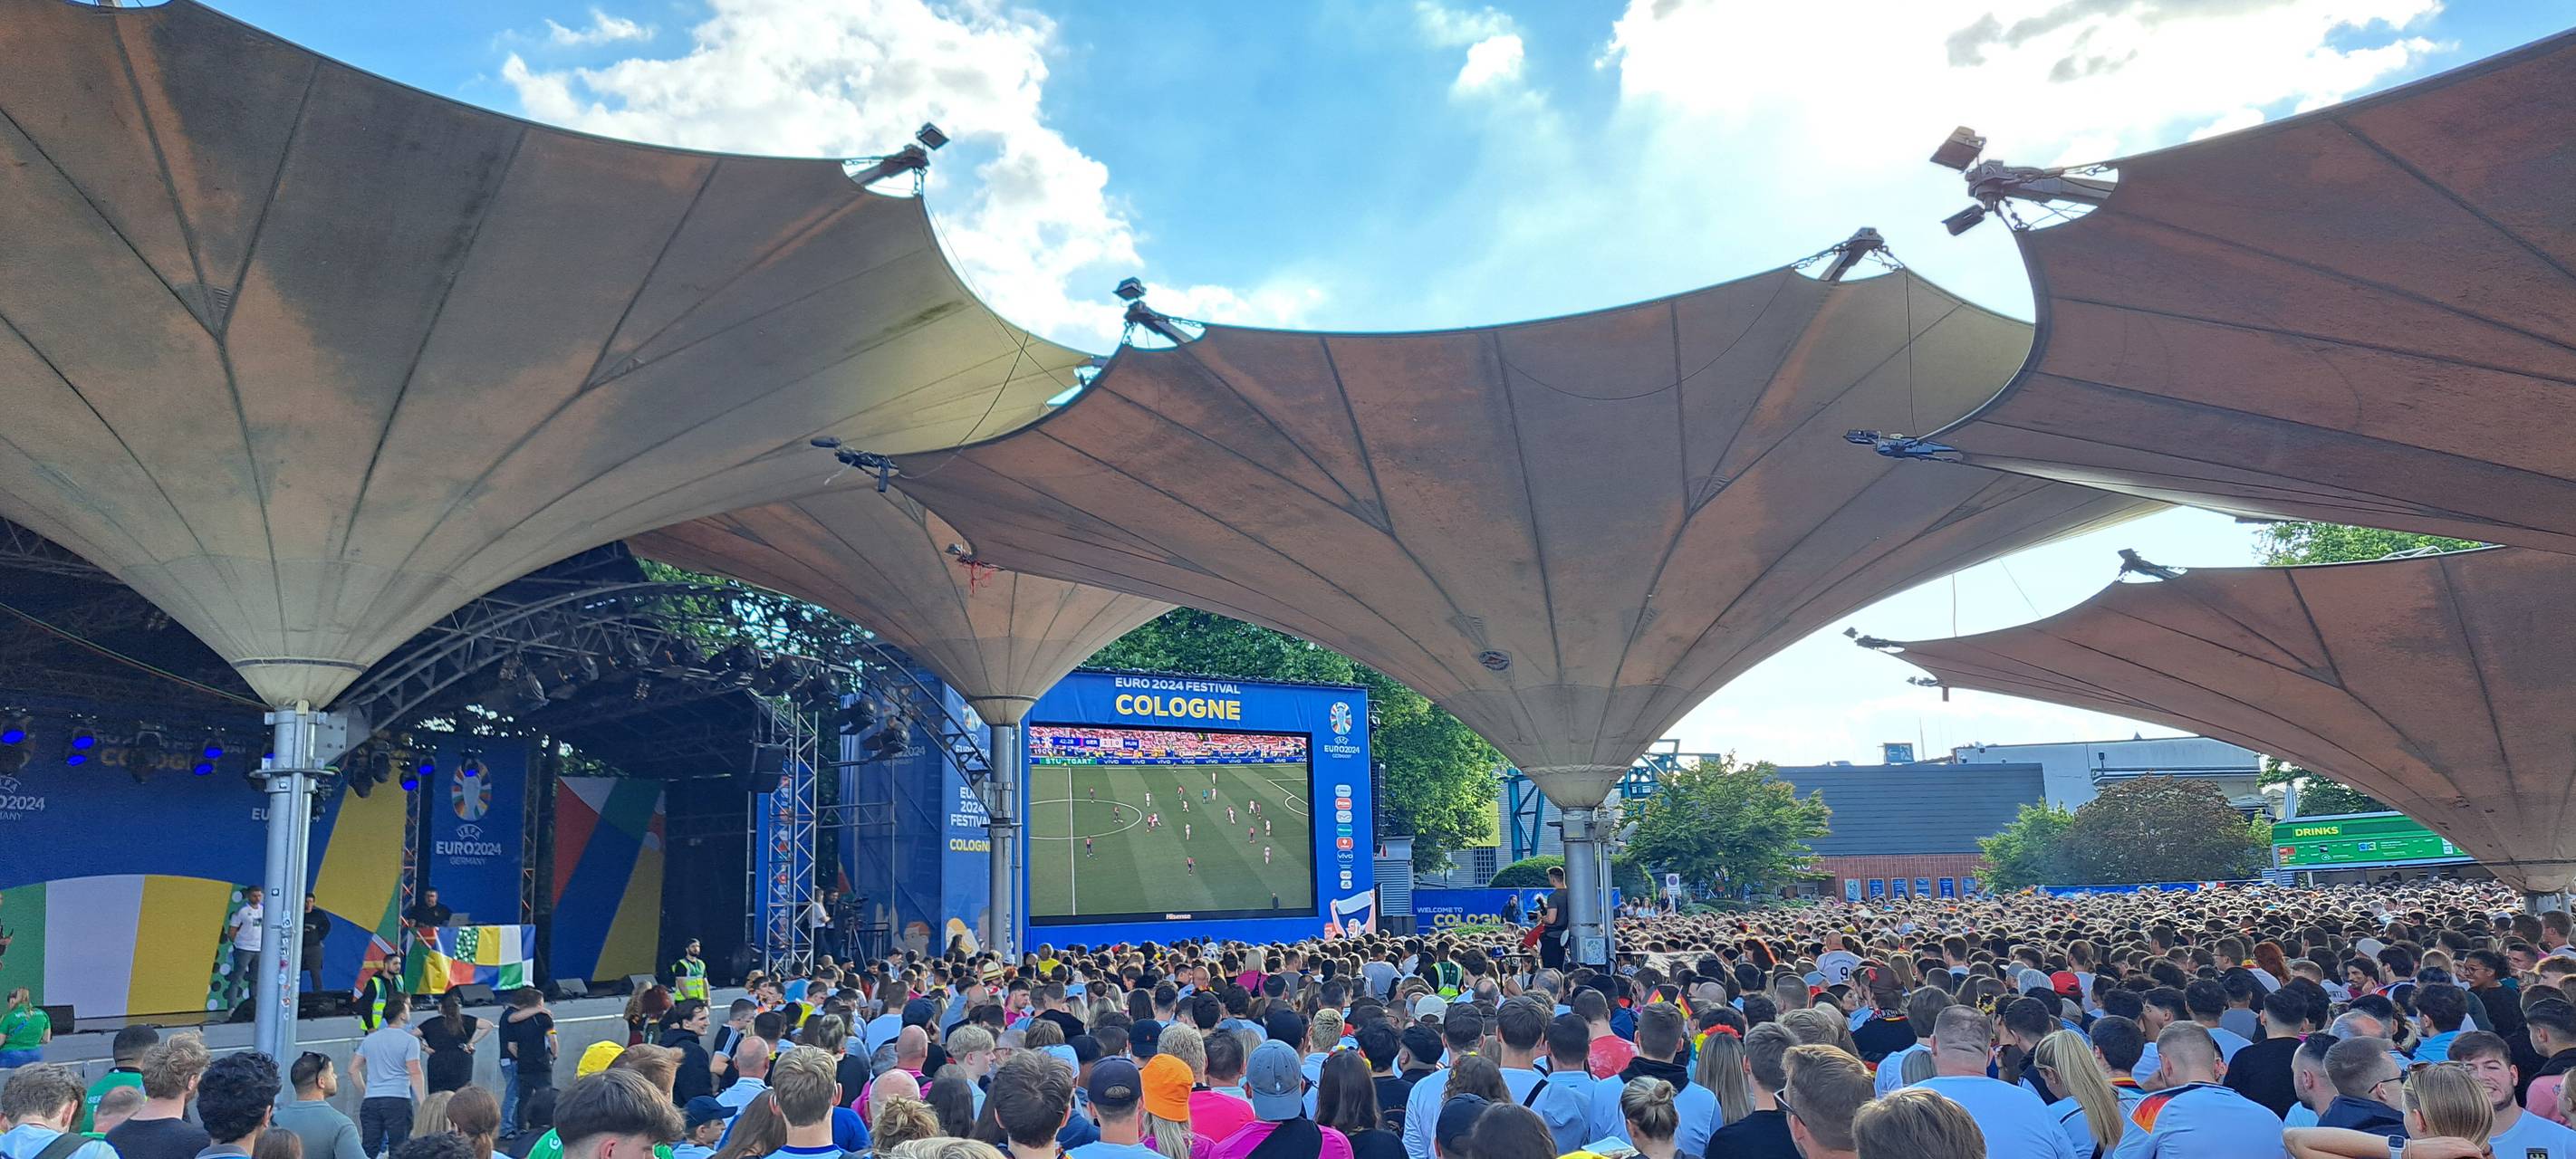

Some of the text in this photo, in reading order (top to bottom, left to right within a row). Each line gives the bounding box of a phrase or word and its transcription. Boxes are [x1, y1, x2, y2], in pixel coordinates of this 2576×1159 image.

[1115, 676, 1241, 694] EURO 2024 FESTIVAL
[1115, 694, 1241, 721] COLOGNE
[1323, 744, 1360, 754] EURO2024
[960, 801, 985, 814] 2024
[2294, 826, 2340, 838] DRINKS
[436, 840, 502, 856] EURO2024
[1434, 914, 1502, 926] COLOGN
[1840, 966, 1849, 981] 9
